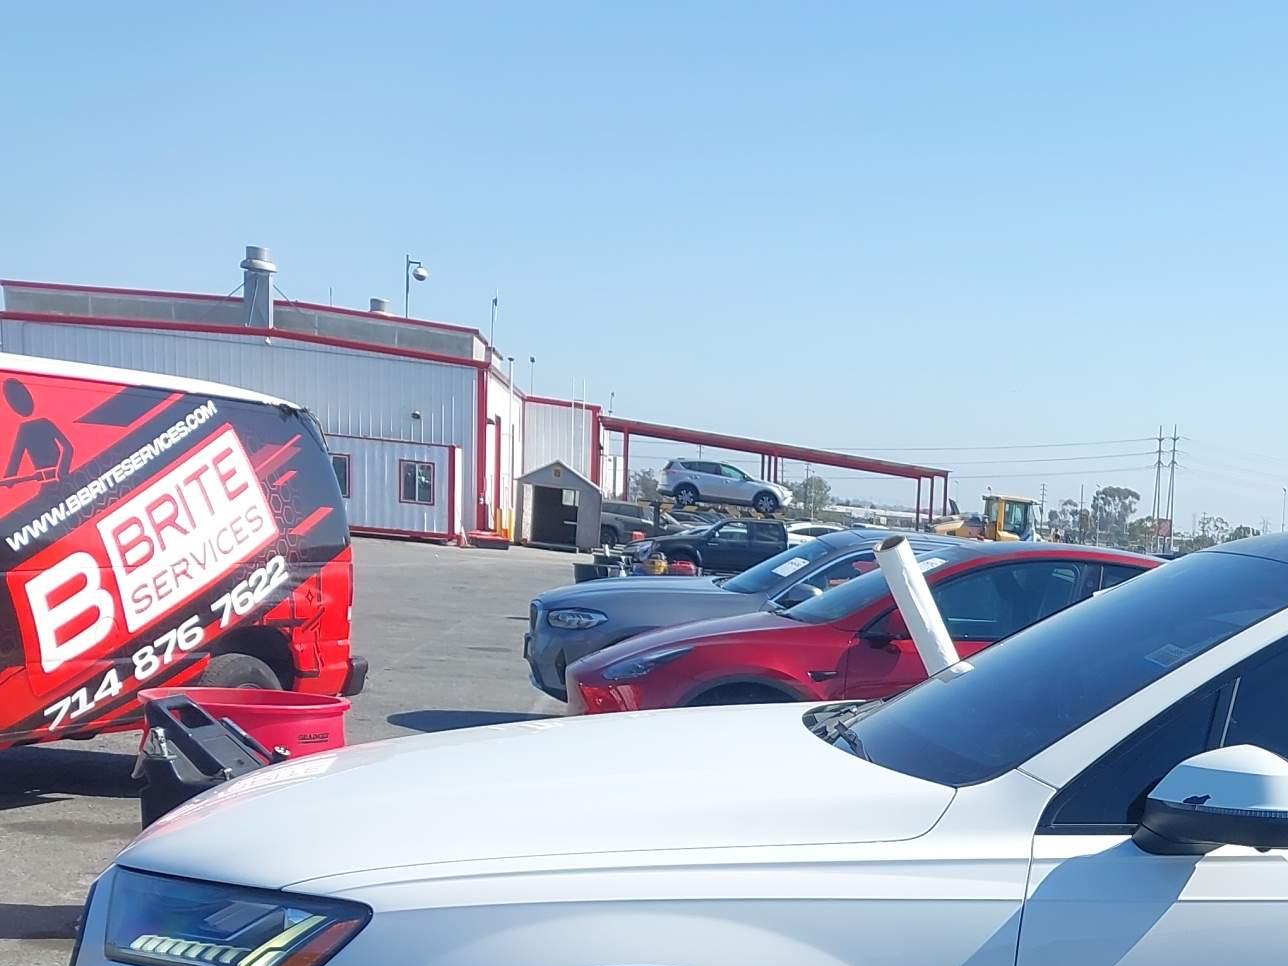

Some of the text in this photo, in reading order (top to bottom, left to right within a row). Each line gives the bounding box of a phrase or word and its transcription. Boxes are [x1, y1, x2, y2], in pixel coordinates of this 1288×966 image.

[5, 399, 218, 552] WWW.BBRITESERVICES.COM
[24, 446, 250, 674] B BRITE
[130, 504, 265, 615] SERVICES
[43, 555, 290, 731] 714 876 7622
